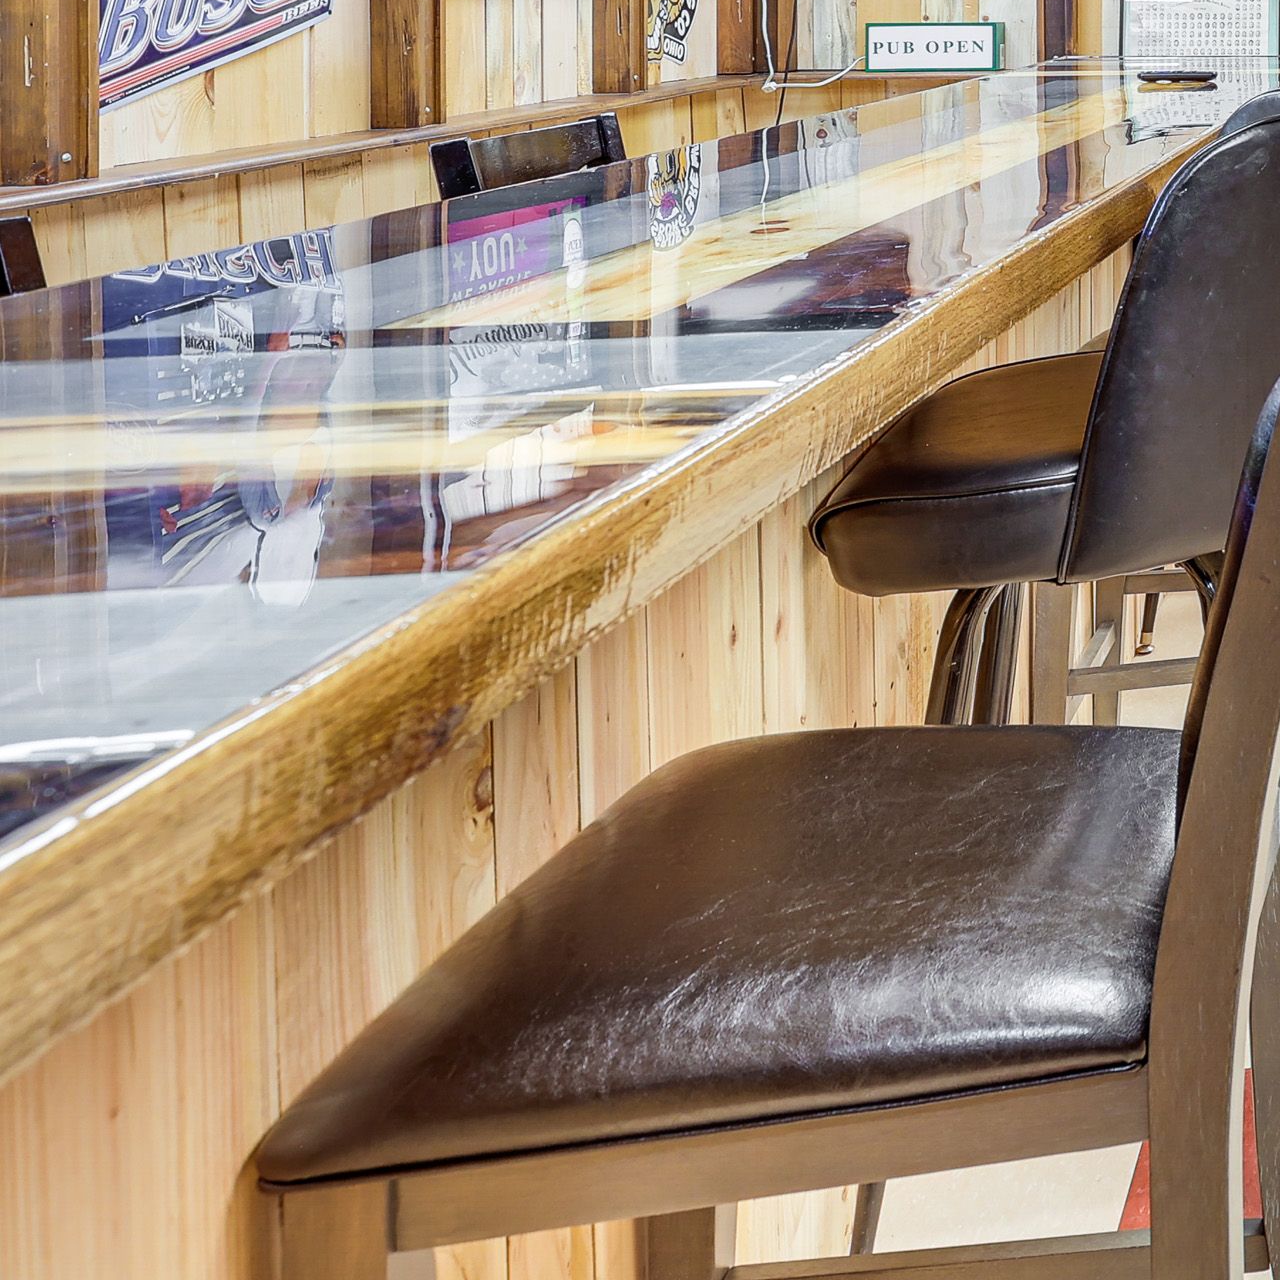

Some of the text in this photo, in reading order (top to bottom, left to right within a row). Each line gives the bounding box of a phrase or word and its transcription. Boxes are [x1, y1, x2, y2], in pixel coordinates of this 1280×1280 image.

[663, 38, 685, 61] OHIO
[873, 40, 985, 54] PUB OPEN
